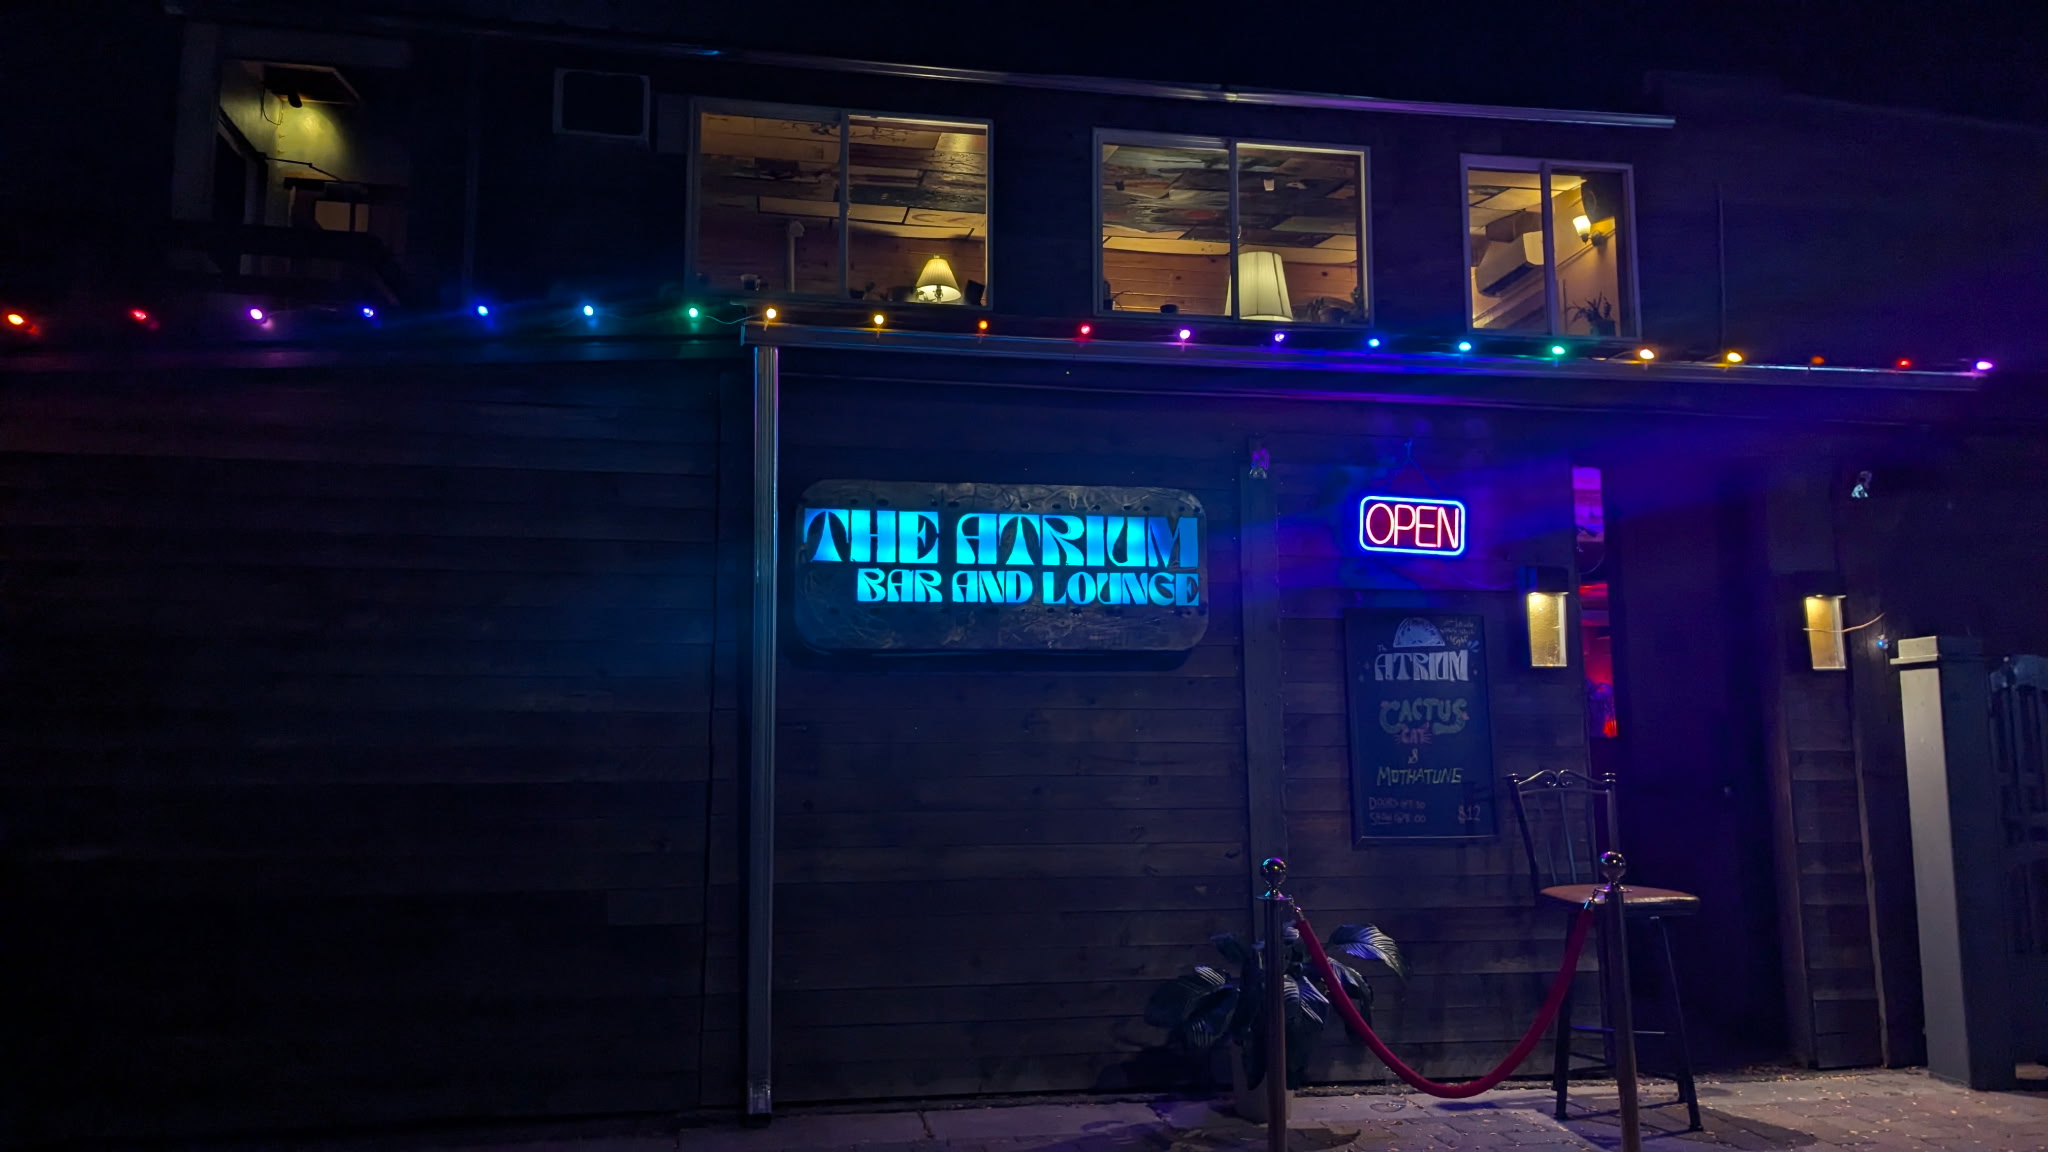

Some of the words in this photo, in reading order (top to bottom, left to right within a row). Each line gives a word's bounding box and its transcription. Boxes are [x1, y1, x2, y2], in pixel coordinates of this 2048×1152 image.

[803, 507, 940, 564] THE
[956, 512, 1200, 569] ATRIUM
[1365, 502, 1459, 549] OPEN
[857, 568, 942, 603] BAR
[951, 569, 1034, 604] AND
[1042, 571, 1200, 607] LOUNGE
[1374, 649, 1469, 682] ATRIUM
[1379, 697, 1469, 735] CACTUS
